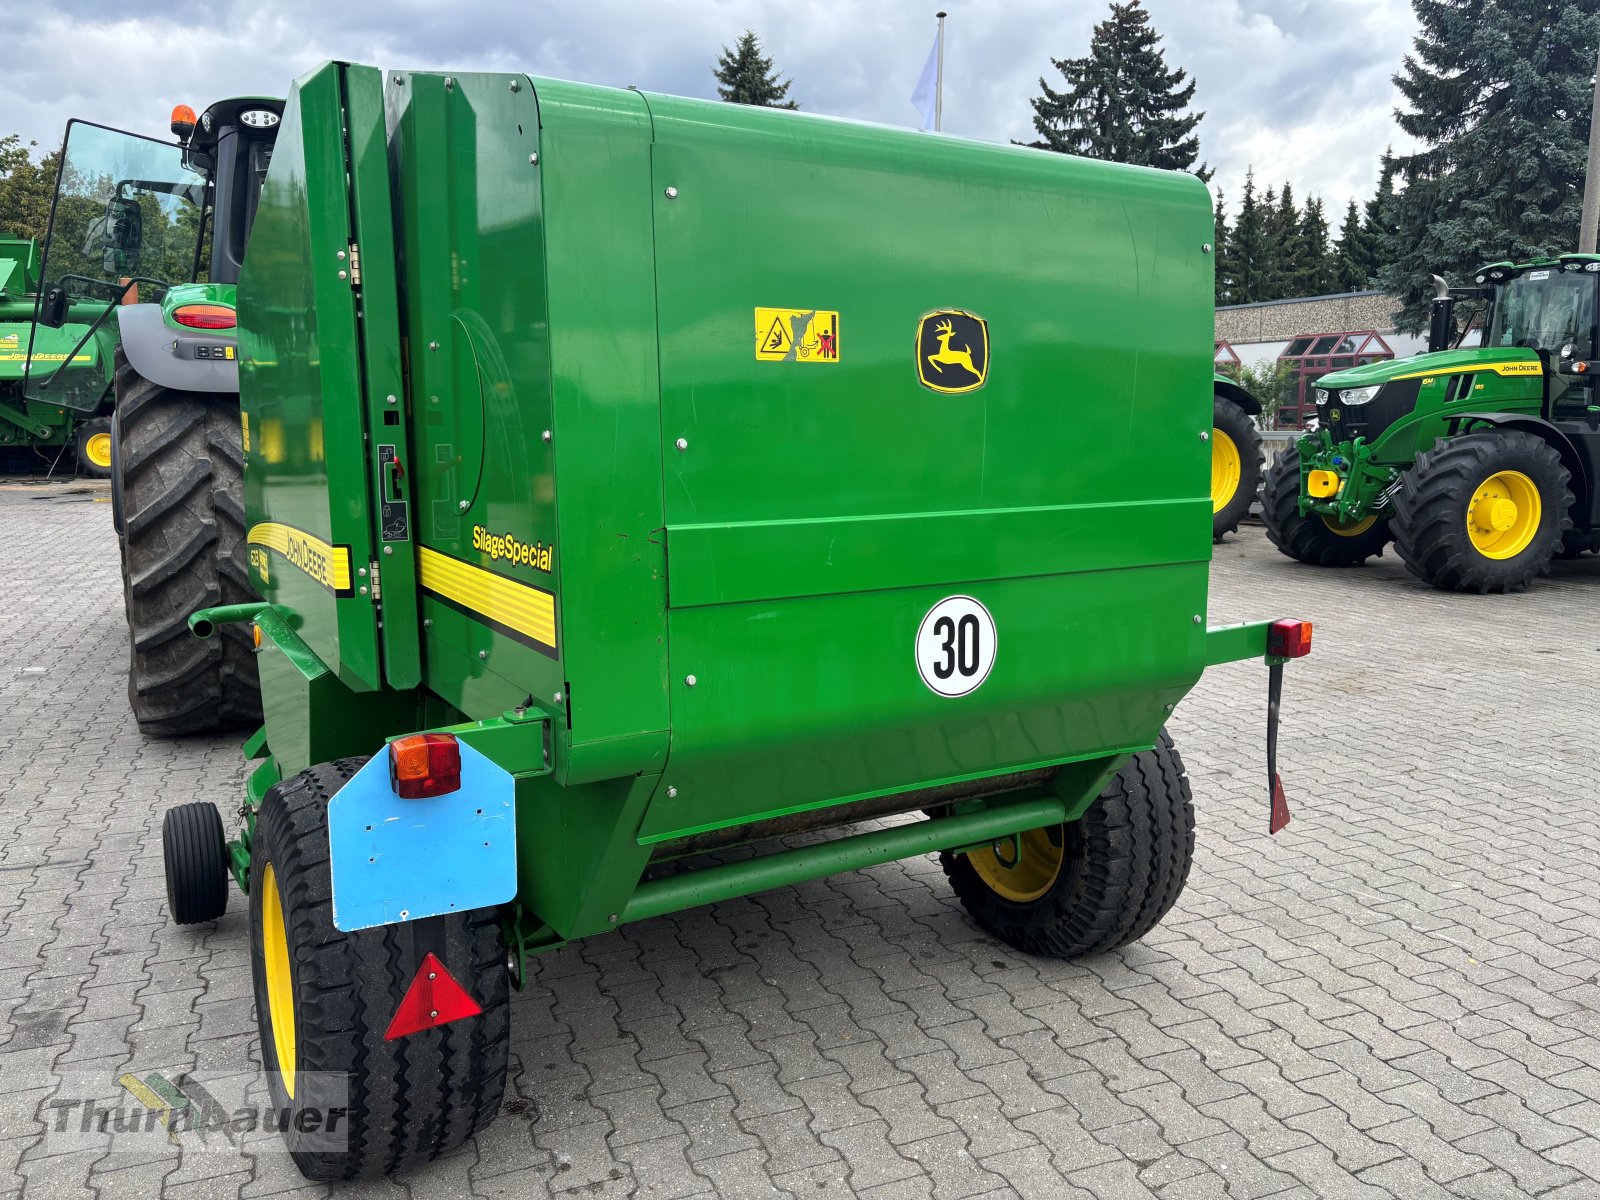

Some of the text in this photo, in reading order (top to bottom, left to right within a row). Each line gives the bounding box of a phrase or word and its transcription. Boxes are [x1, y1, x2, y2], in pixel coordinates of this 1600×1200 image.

[1501, 364, 1538, 372] JOHN DEERE
[286, 530, 304, 570] JOHN
[302, 538, 329, 587] DEERE
[473, 524, 553, 573] SilageSpecial
[933, 613, 980, 680] 30
